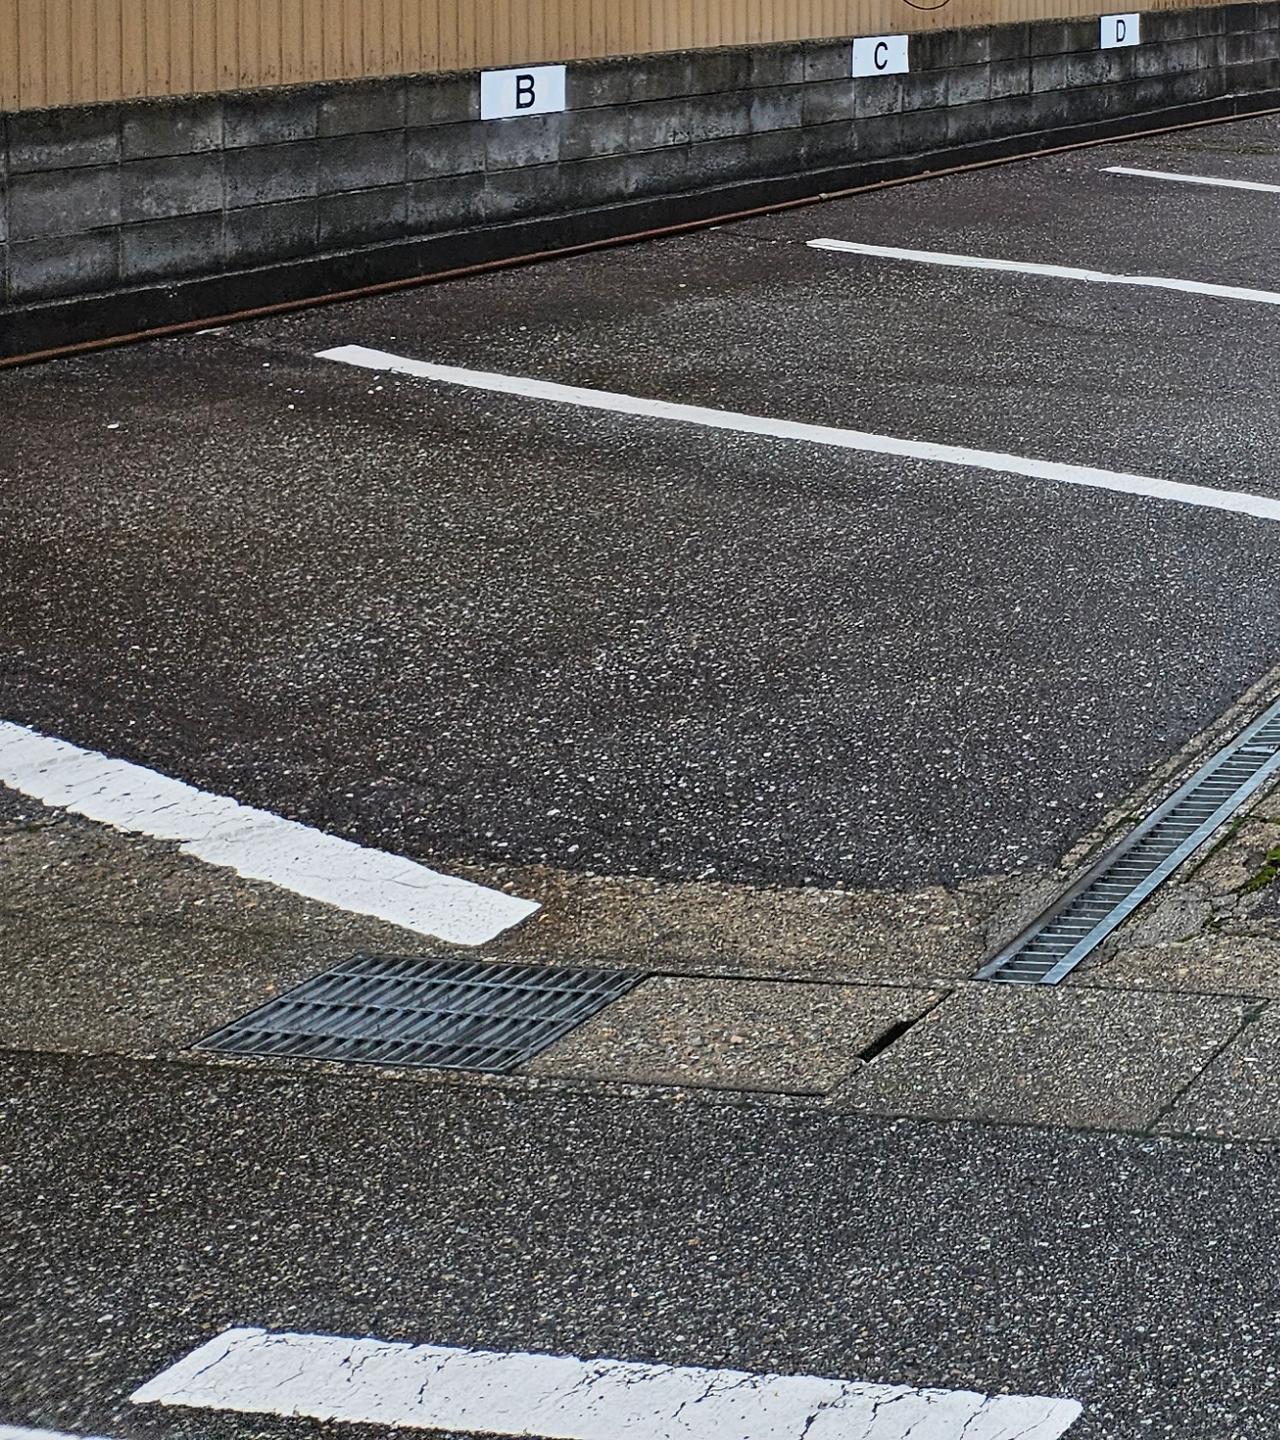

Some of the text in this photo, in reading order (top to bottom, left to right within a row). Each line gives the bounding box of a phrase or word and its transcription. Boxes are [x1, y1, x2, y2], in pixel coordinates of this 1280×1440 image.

[1116, 19, 1126, 42] D
[874, 41, 888, 71] C
[516, 74, 535, 109] B
